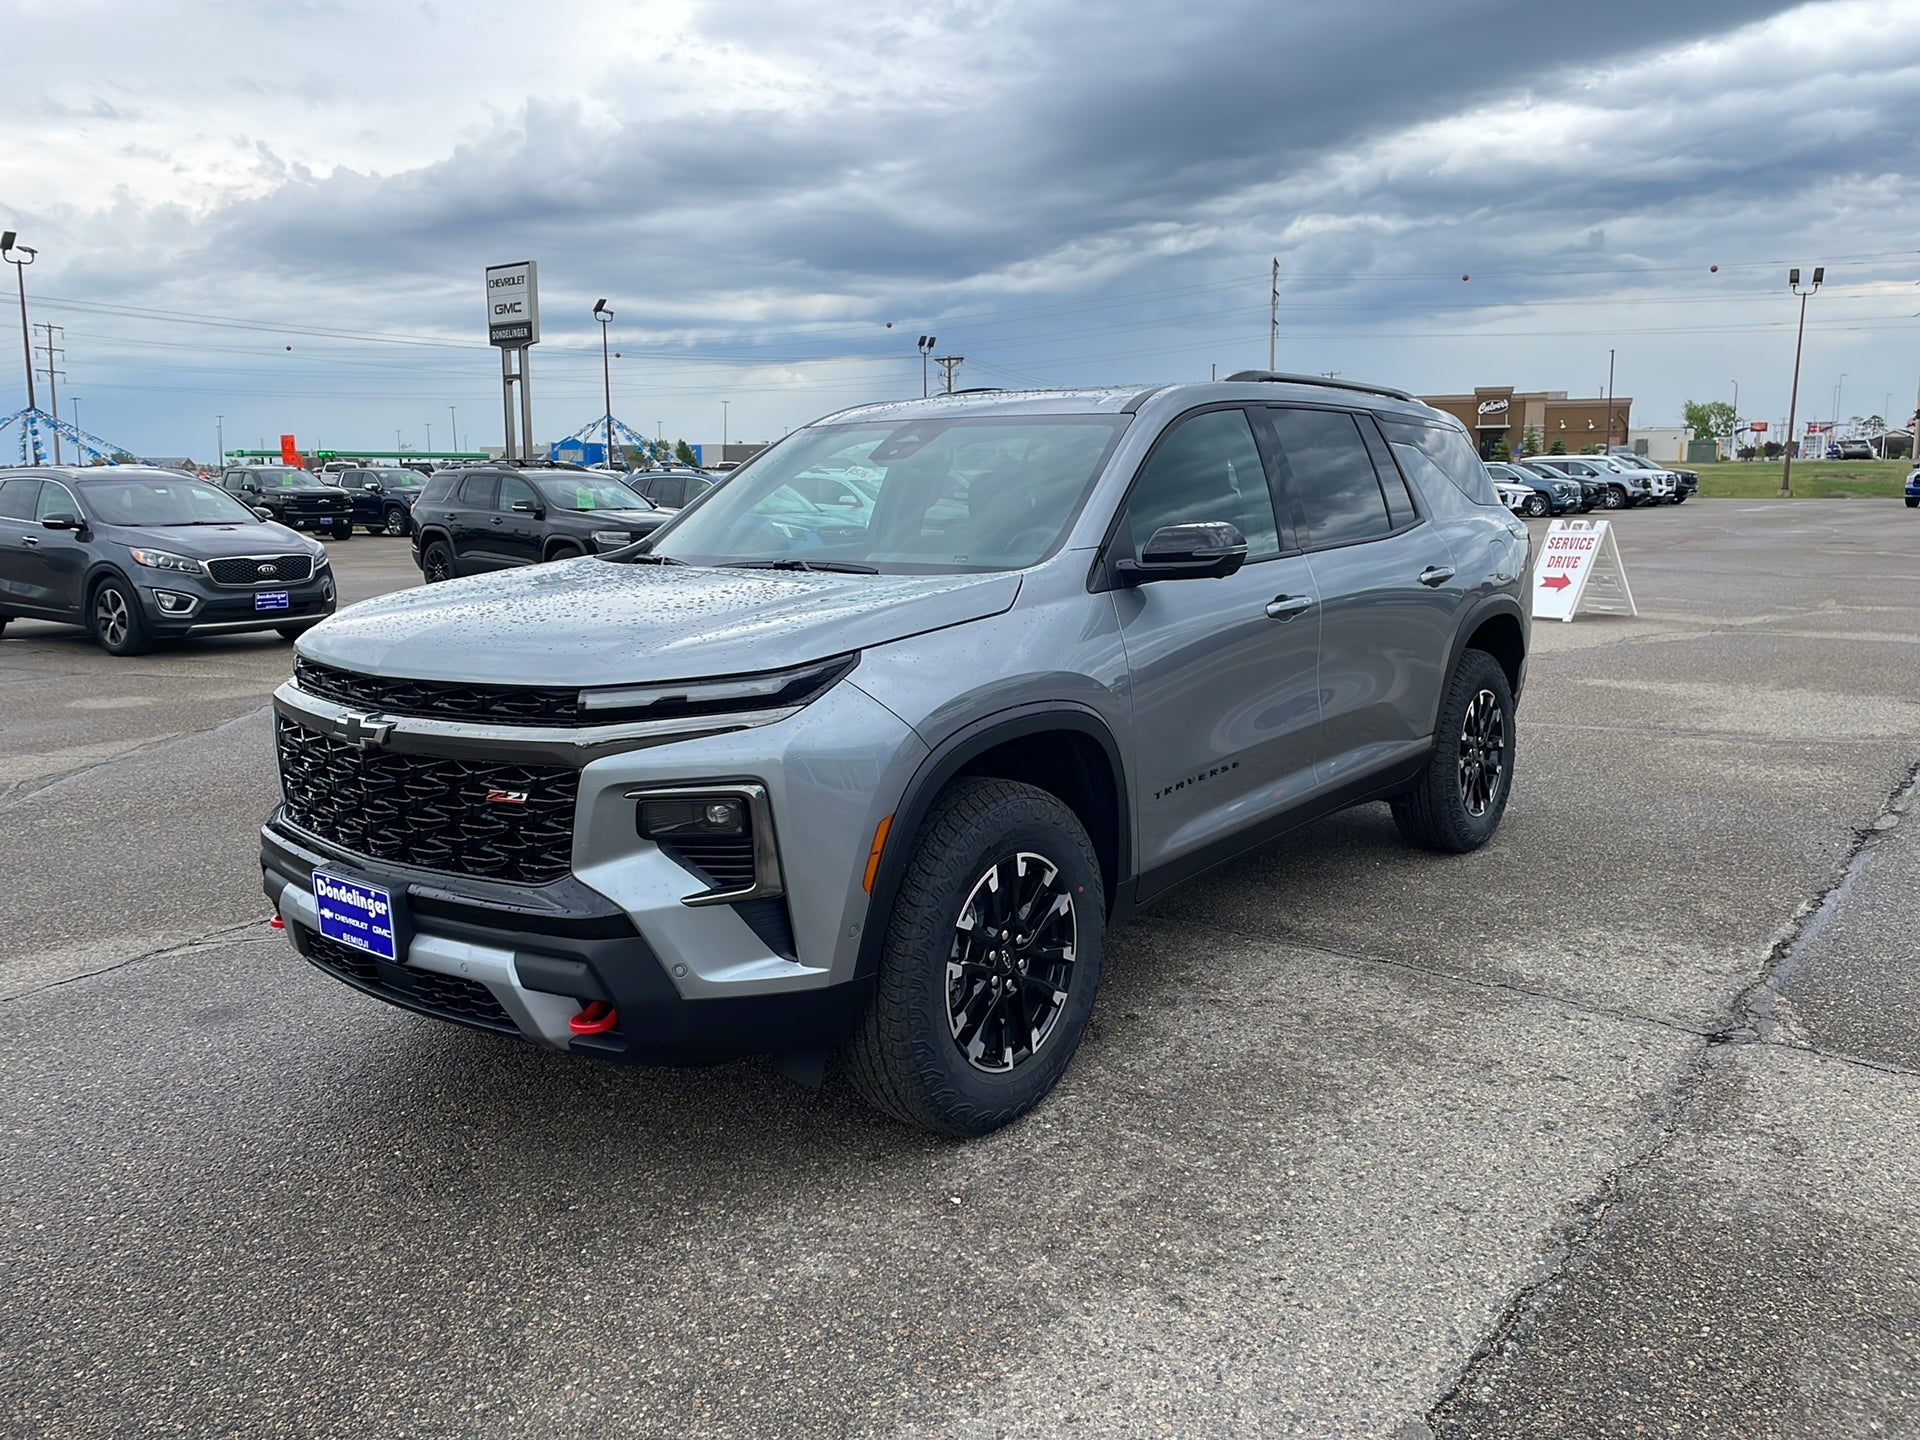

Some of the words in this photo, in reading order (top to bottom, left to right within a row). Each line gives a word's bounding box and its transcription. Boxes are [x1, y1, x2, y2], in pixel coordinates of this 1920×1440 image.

[488, 275, 526, 289] CHEVROLET
[494, 302, 522, 315] GMC
[491, 327, 528, 340] DONDELINGER
[1547, 536, 1595, 550] SERVICE
[1546, 555, 1581, 569] DRIVE
[1153, 761, 1240, 800] TRAVERSE
[485, 789, 529, 804] Z71
[316, 877, 388, 919] Dondelinger
[334, 912, 369, 931] CHEVROLET
[372, 925, 393, 939] GMC
[342, 932, 370, 949] BEMIDJI
